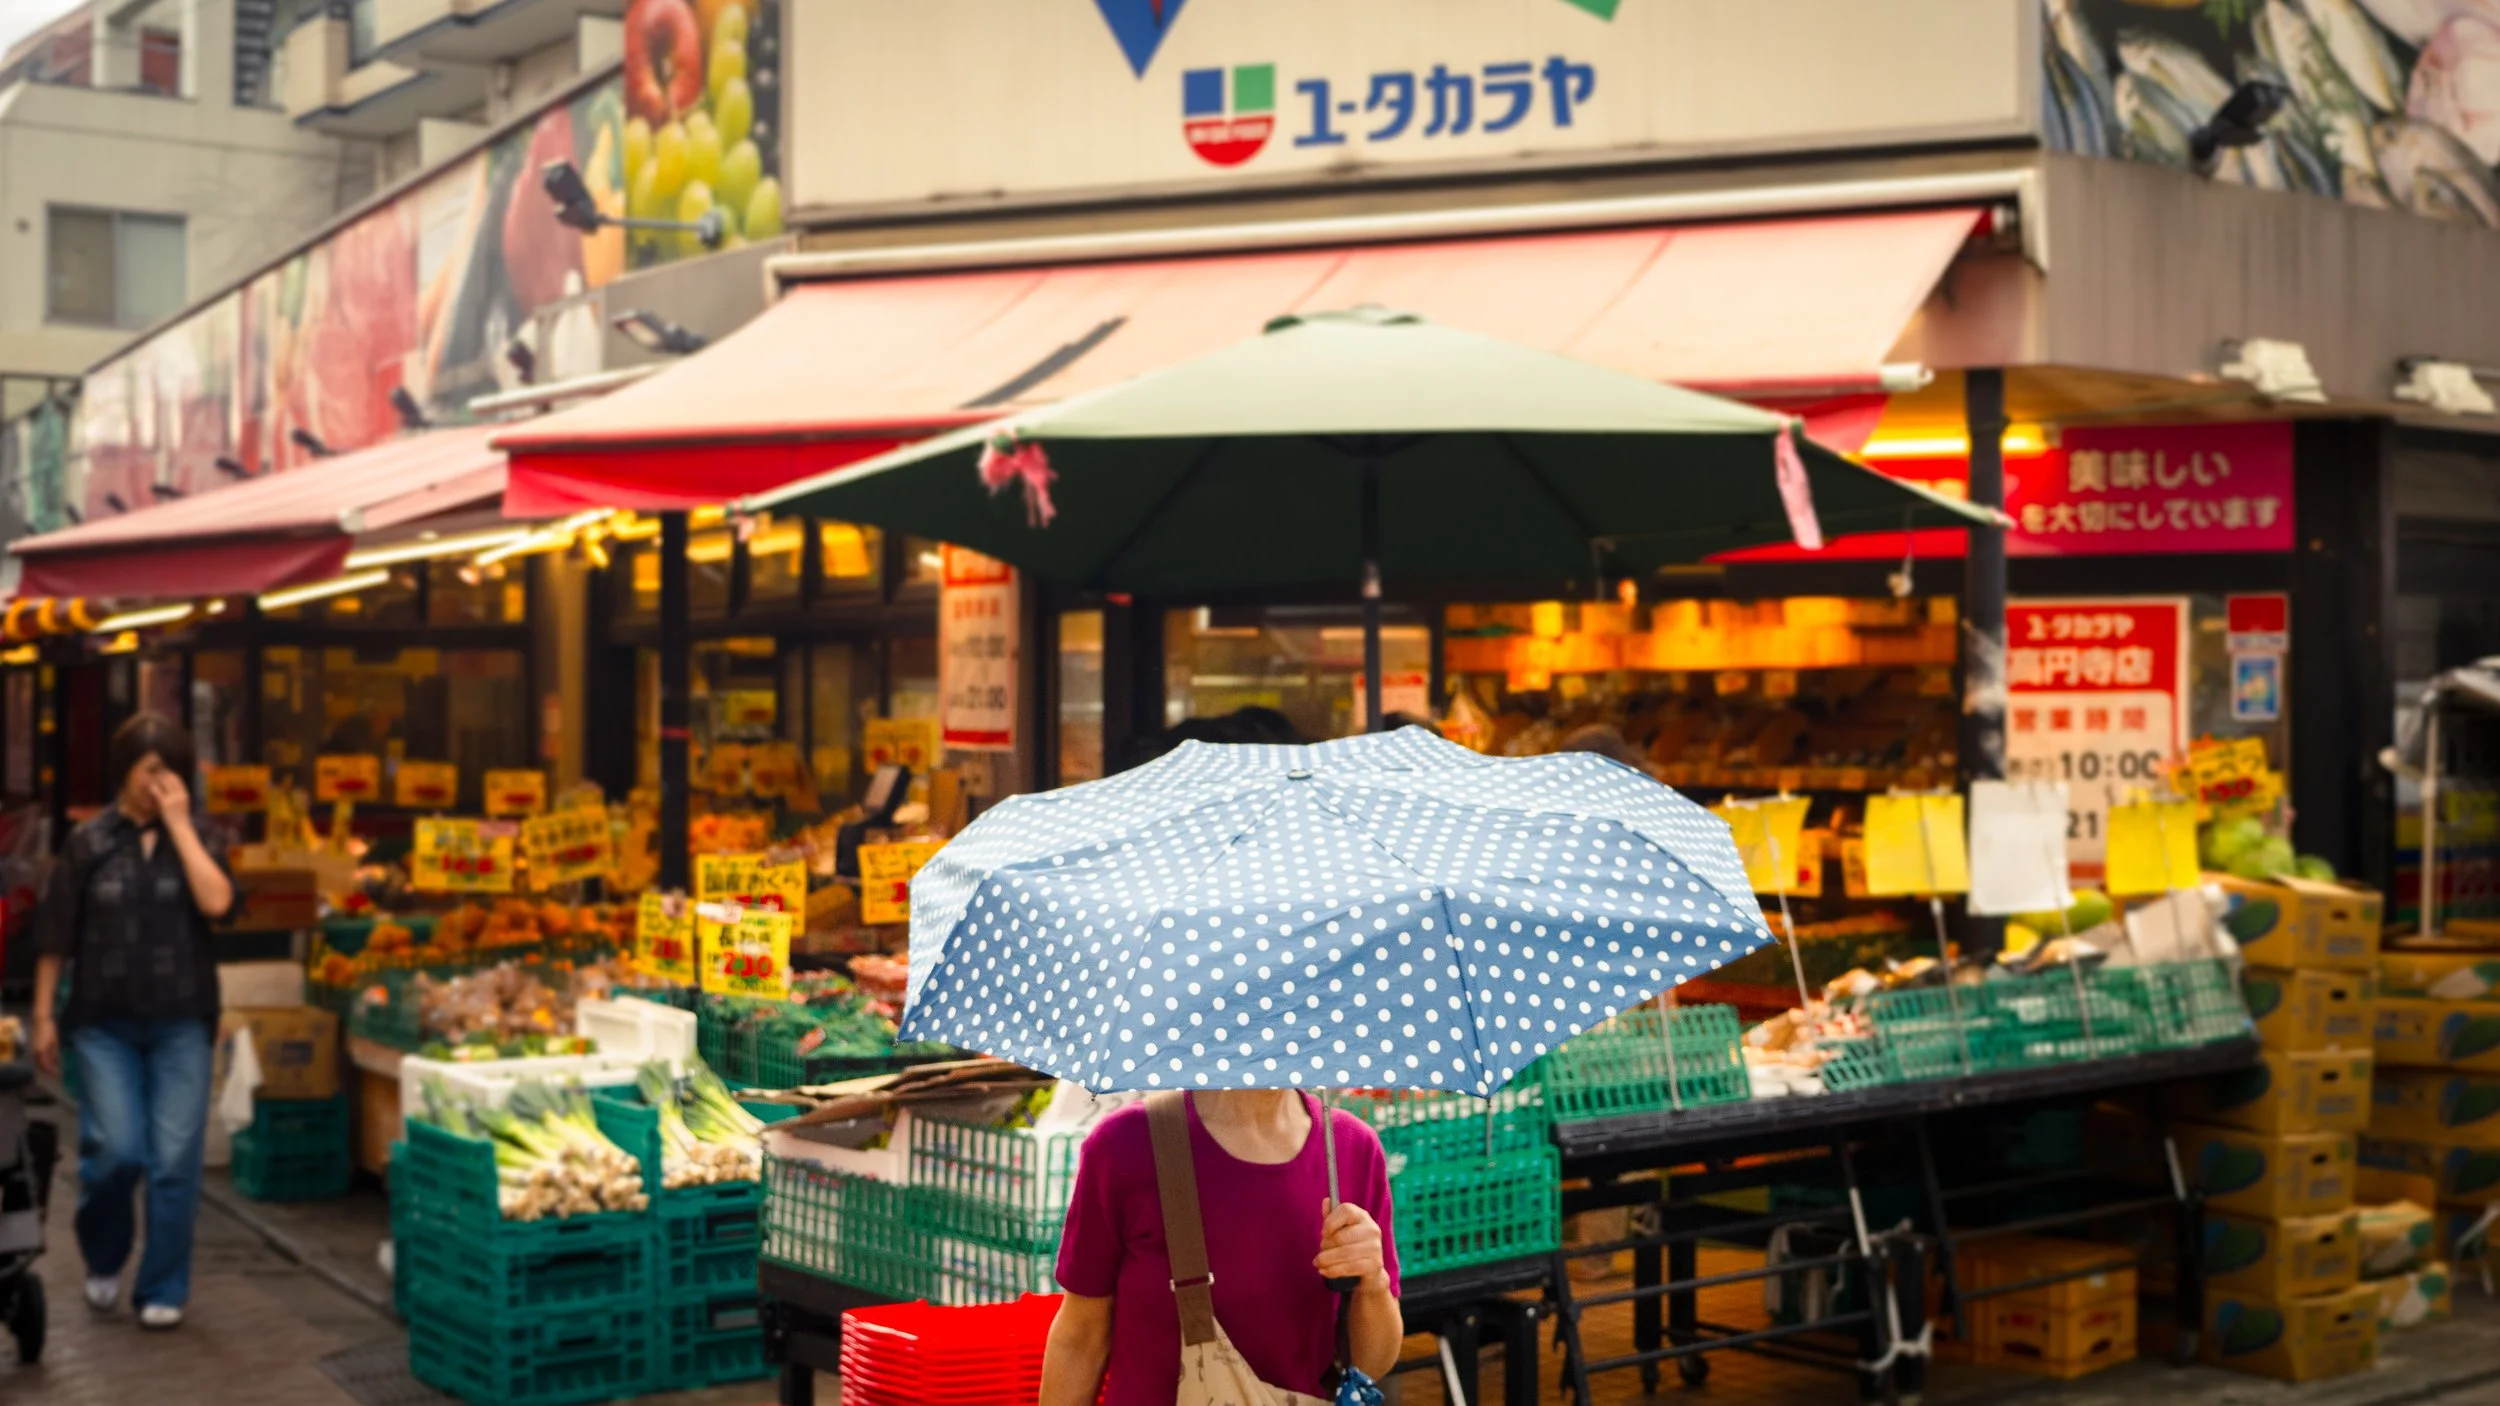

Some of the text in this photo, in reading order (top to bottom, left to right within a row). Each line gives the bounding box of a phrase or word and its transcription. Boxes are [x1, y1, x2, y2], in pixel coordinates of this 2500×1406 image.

[1293, 55, 1596, 148] ユータカラヤ
[2068, 448, 2231, 493] 美味しい
[2021, 495, 2280, 534] を大切にしています
[2007, 646, 2153, 686] 高円寺店
